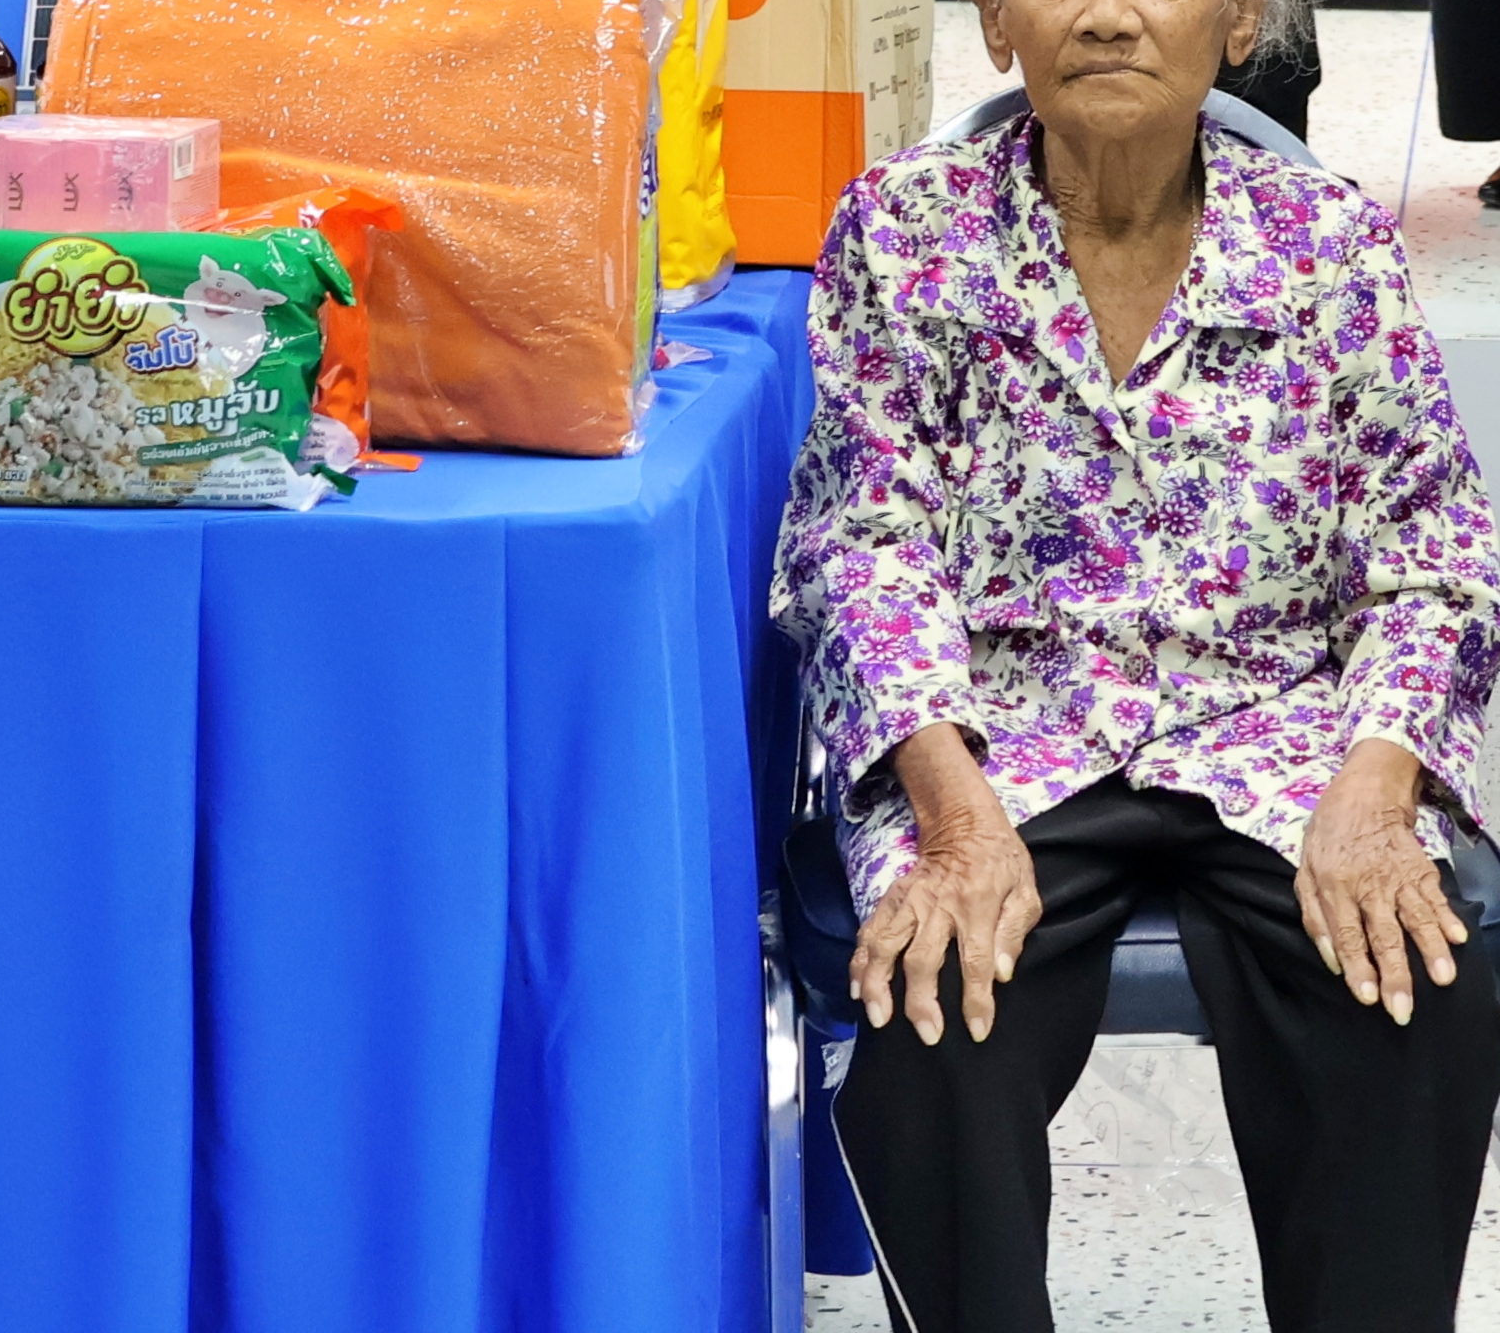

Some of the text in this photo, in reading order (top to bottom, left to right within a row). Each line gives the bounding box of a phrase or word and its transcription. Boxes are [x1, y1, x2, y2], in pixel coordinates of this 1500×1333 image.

[8, 171, 24, 211] LUX
[63, 171, 80, 212] LUX
[5, 259, 150, 343] ยำยำ
[125, 324, 199, 375] จัมโบ้
[170, 379, 281, 436] หมูสับ
